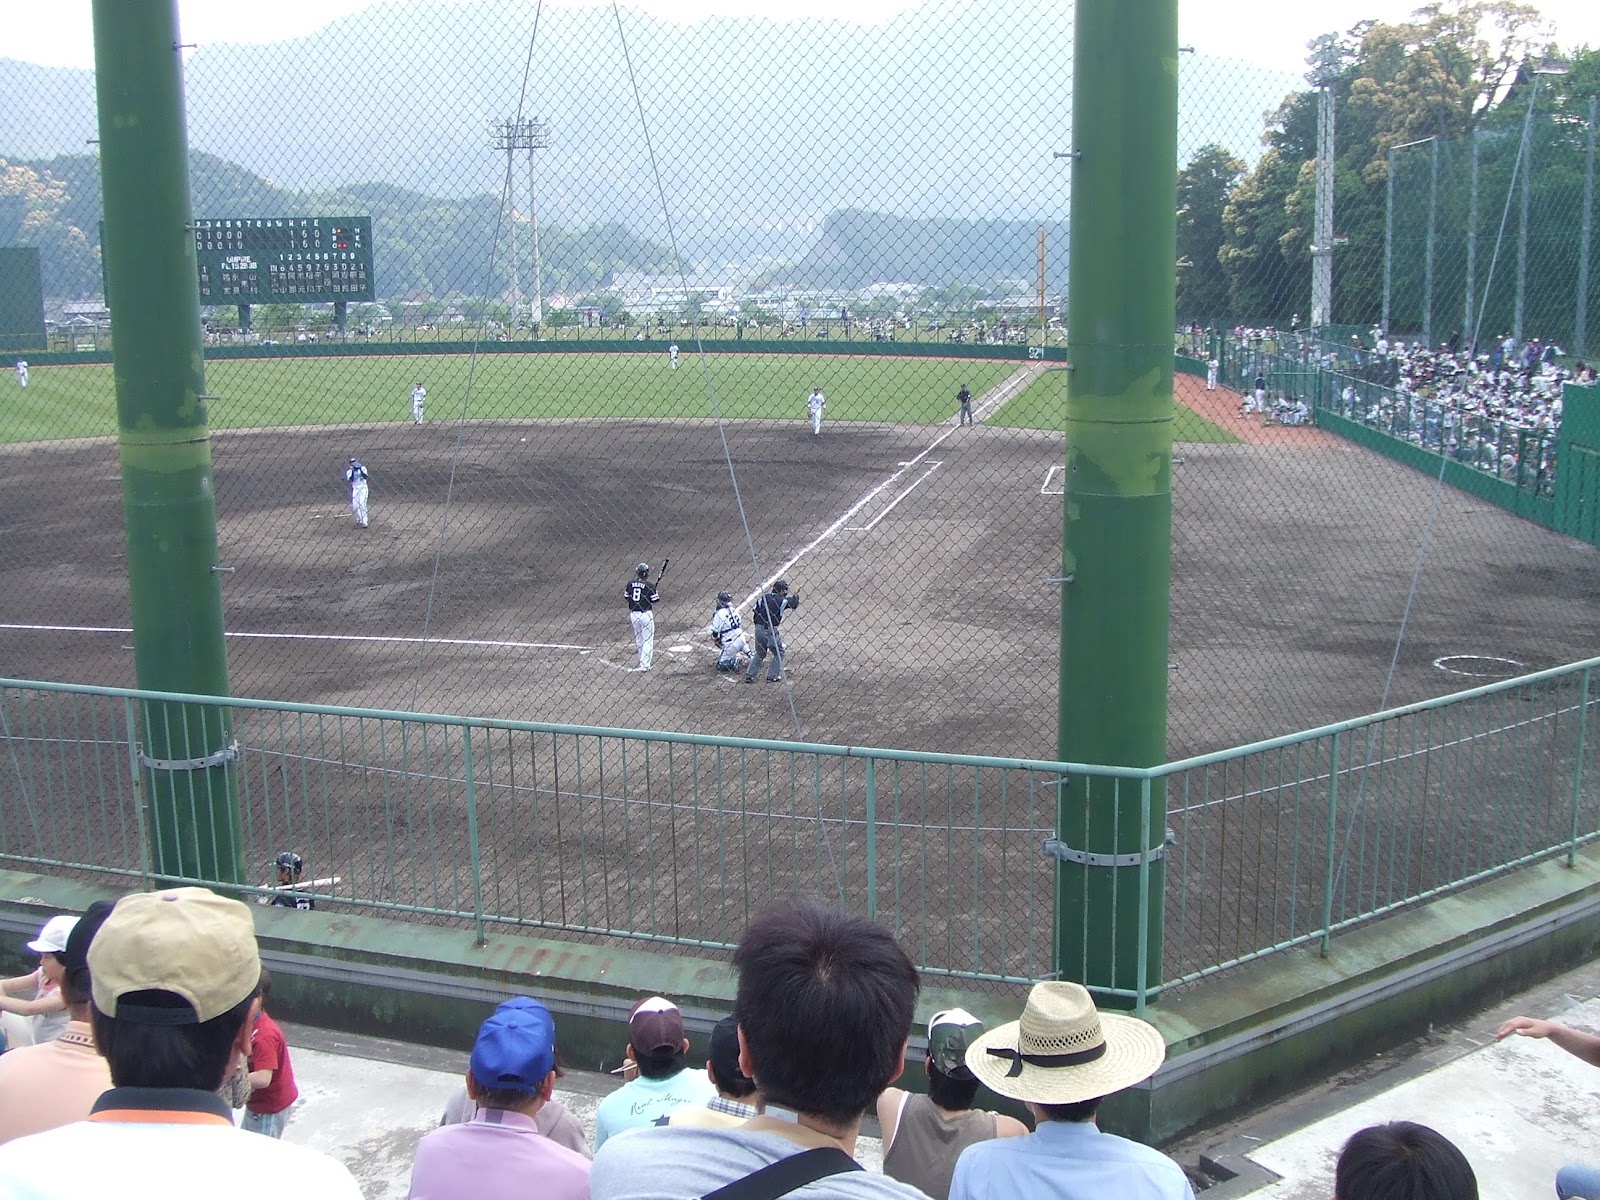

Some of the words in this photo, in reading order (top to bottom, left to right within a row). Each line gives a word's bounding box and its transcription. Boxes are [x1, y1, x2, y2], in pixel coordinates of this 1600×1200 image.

[226, 220, 231, 228] 5
[236, 220, 242, 228] 6
[246, 220, 252, 228] 7
[226, 231, 232, 239] 0
[237, 231, 242, 239] 0
[633, 588, 641, 602] 8
[630, 1098, 653, 1116] Real
